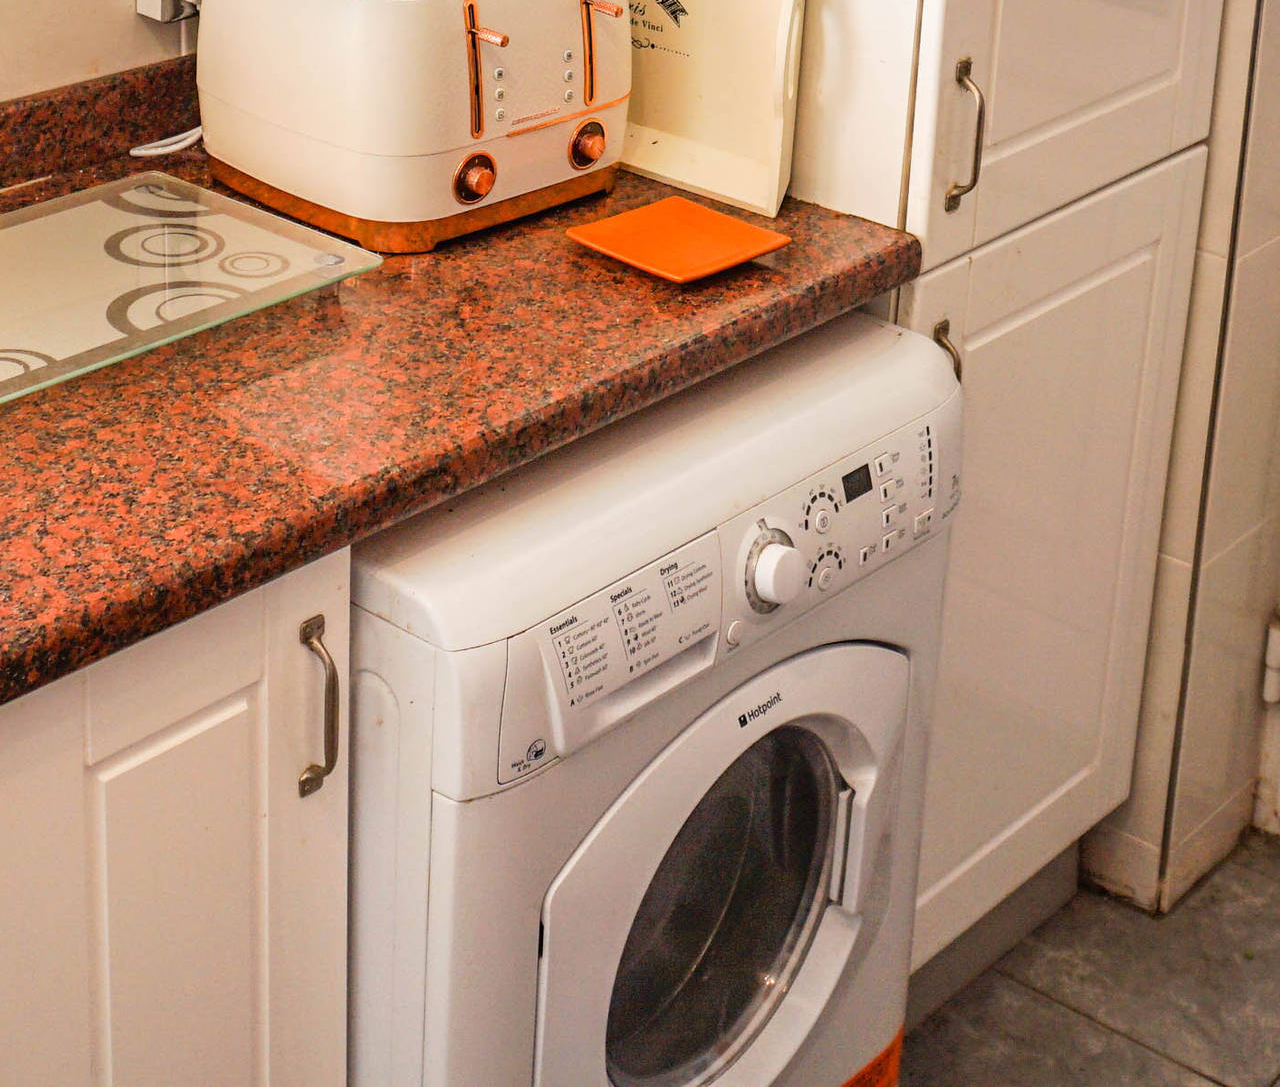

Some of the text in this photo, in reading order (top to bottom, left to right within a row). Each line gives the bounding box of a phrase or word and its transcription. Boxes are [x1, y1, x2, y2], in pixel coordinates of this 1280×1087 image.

[642, 19, 664, 33] Vinci
[660, 562, 679, 576] Drying
[609, 586, 633, 603] Specials
[549, 615, 578, 635] Essentials
[747, 692, 782, 722] Hotpoint
